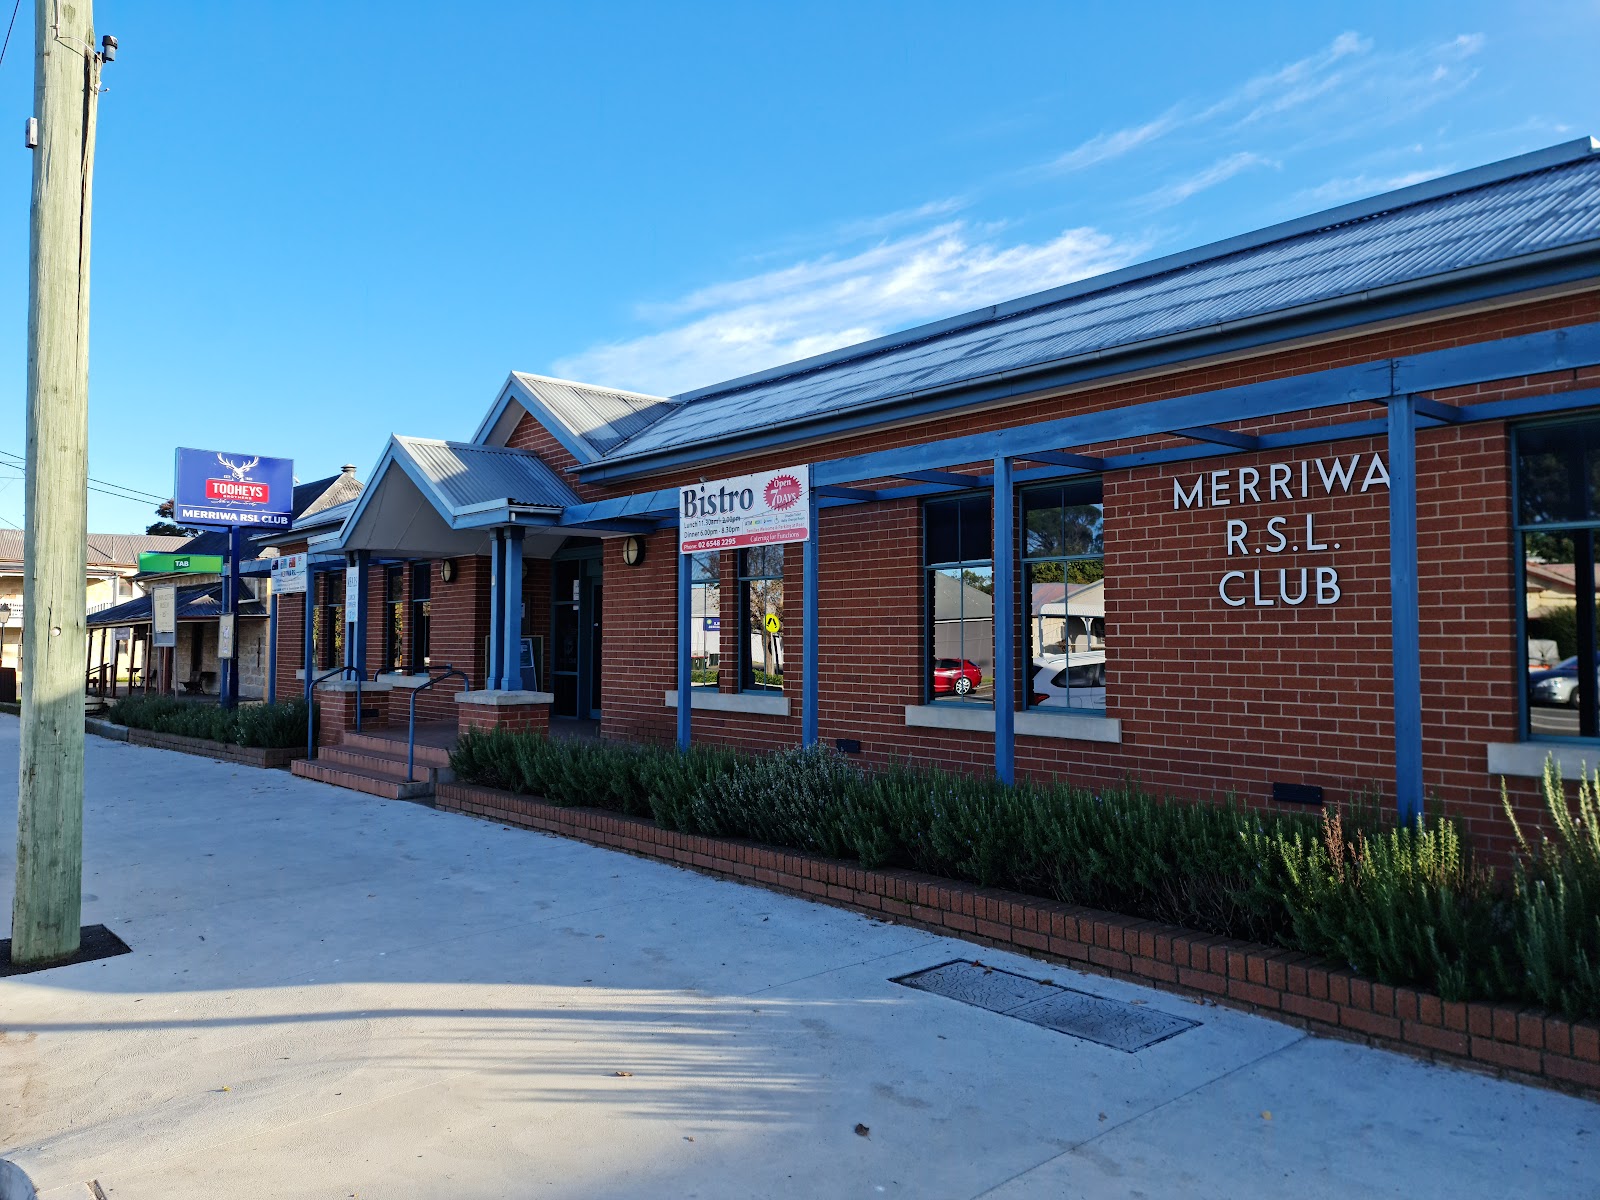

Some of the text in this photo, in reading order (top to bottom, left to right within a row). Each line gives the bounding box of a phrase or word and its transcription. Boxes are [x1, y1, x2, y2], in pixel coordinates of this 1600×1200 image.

[773, 479, 792, 490] Open
[1173, 452, 1391, 510] MERRIWA
[212, 482, 263, 498] TOOHEYS
[682, 484, 754, 519] Bistro
[182, 509, 289, 525] MERRIWA RSL CLUB
[683, 531, 699, 539] Dinner
[750, 534, 770, 543] Catering
[777, 531, 800, 540] Functions
[1227, 513, 1341, 556] R.S.L.
[698, 541, 705, 549] 02
[706, 539, 720, 548] 6548
[721, 538, 736, 546] 2295
[1219, 567, 1341, 607] CLUB
